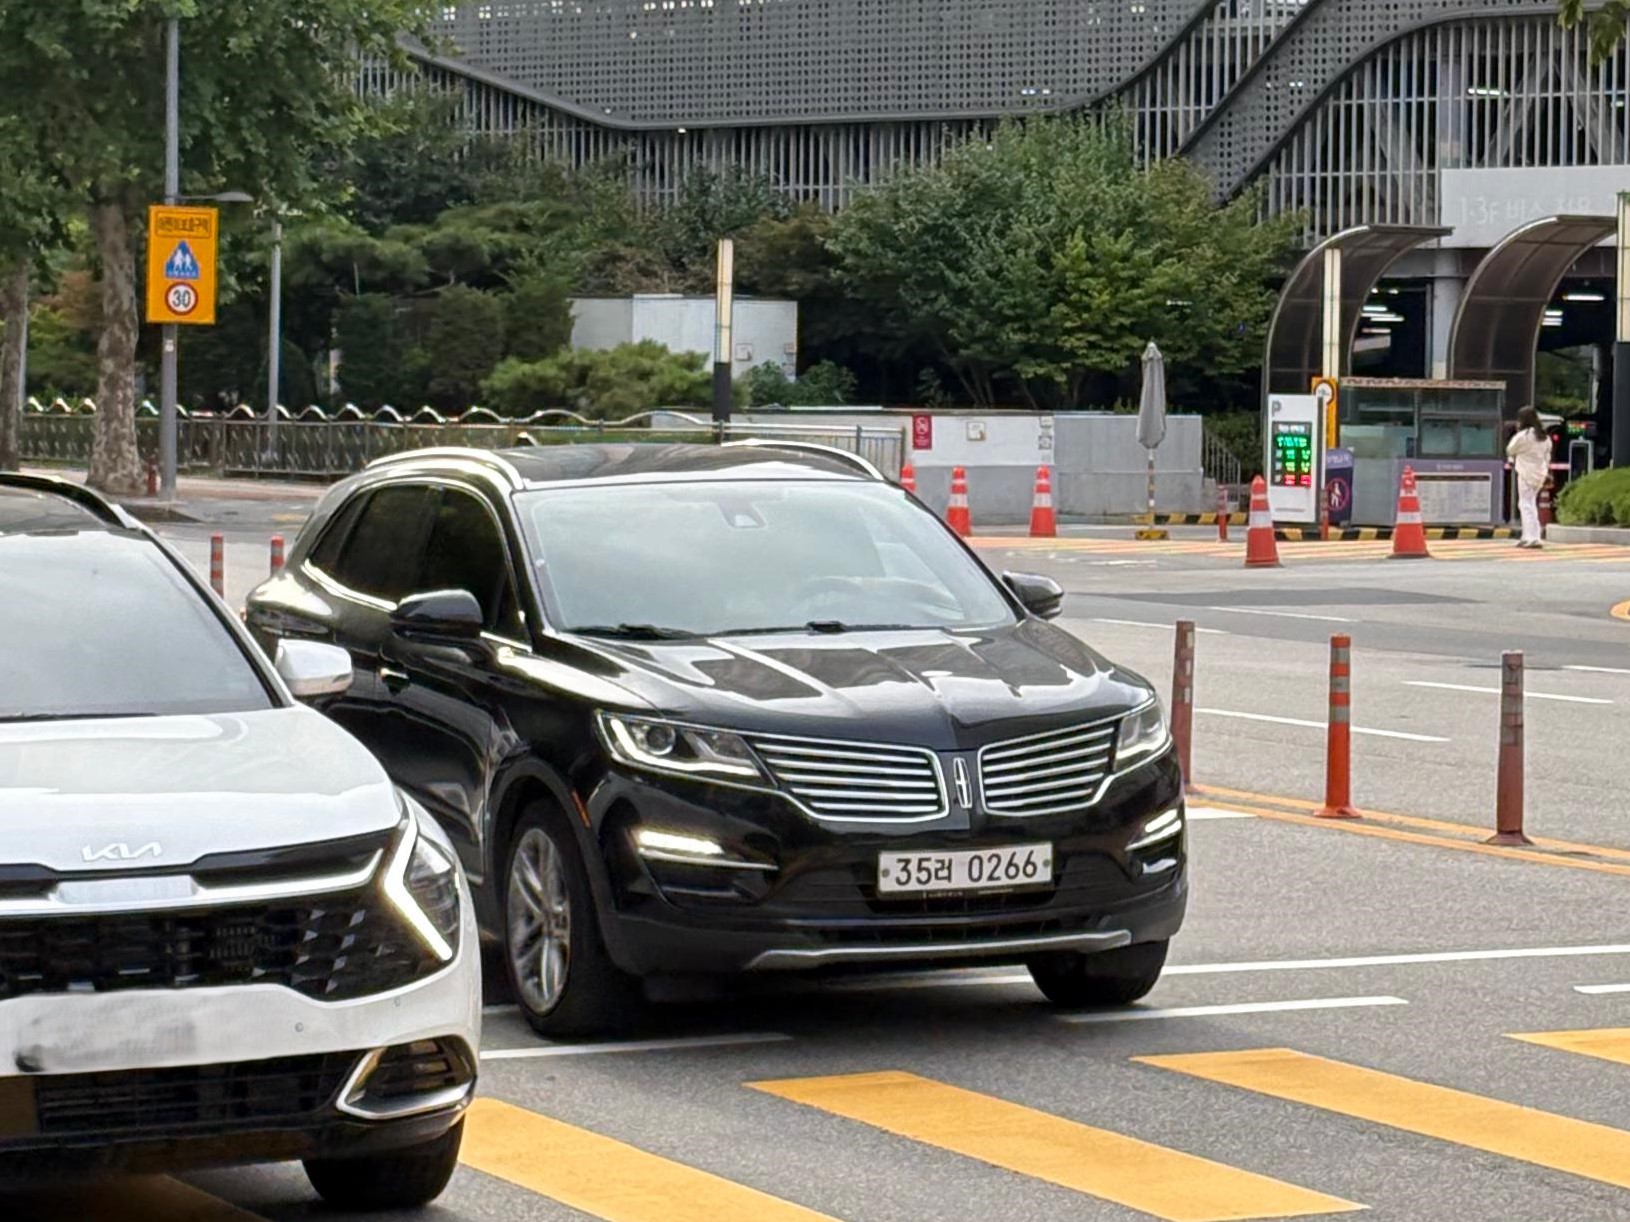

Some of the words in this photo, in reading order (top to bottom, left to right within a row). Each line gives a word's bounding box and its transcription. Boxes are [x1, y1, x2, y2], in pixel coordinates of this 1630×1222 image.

[172, 289, 192, 308] 30
[81, 841, 163, 863] KIA
[895, 857, 953, 887] 35러
[967, 850, 1038, 884] 0266
